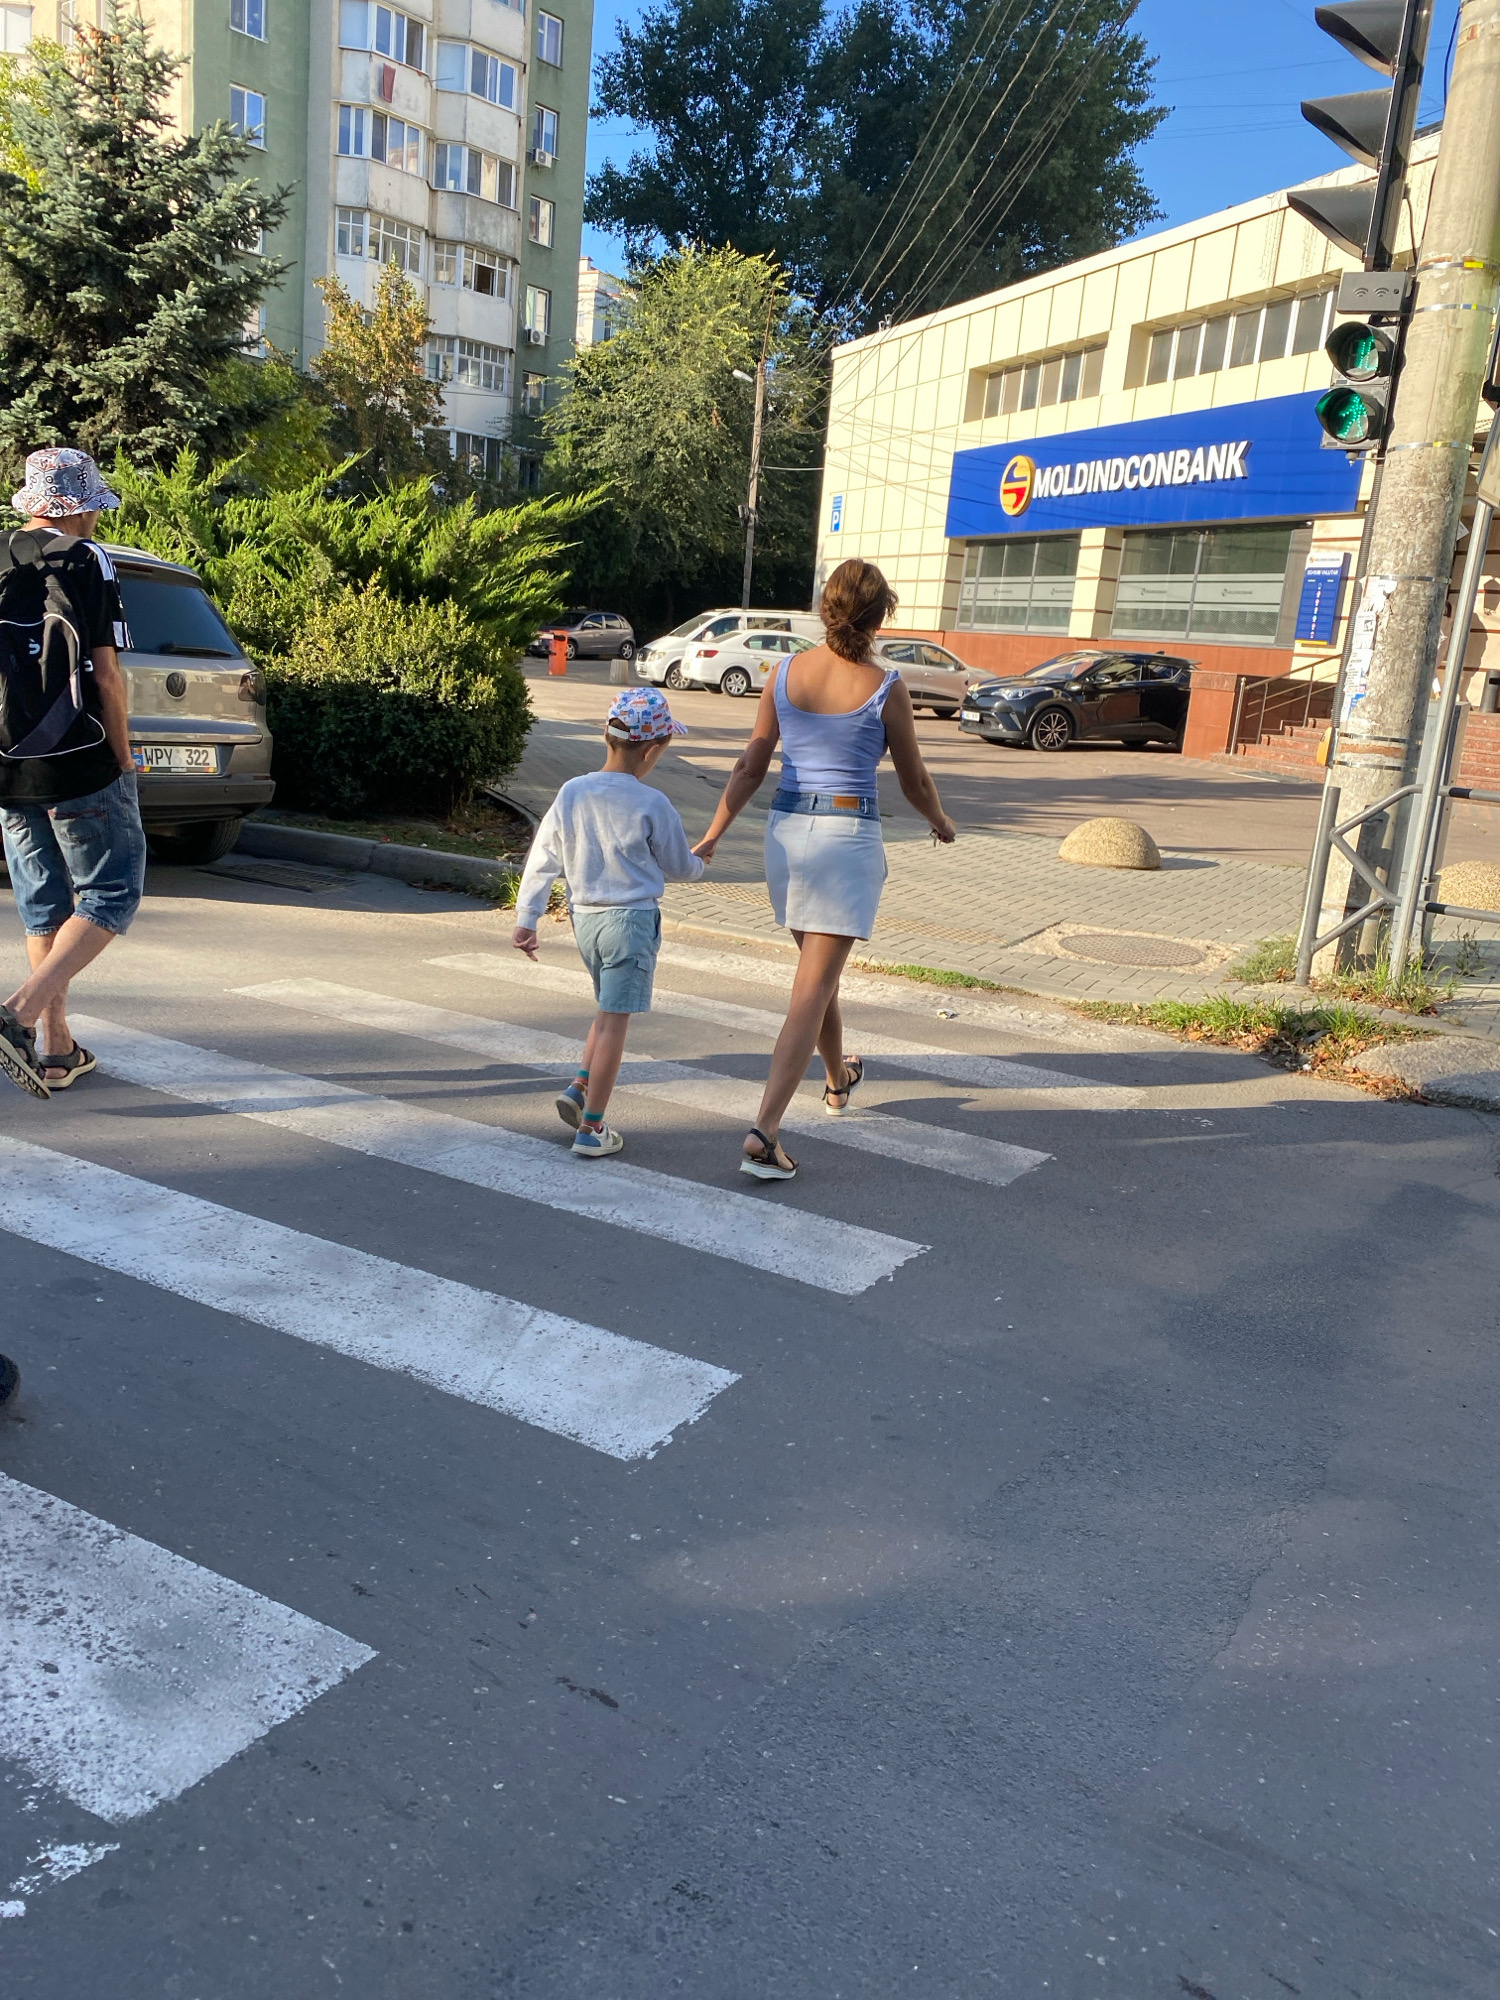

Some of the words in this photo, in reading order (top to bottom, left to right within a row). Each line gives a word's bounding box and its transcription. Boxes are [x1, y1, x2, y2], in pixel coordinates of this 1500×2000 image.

[1032, 440, 1251, 499] MOLDINDCONBANK
[831, 511, 840, 532] P
[144, 748, 173, 766] WPY
[185, 749, 210, 766] 322
